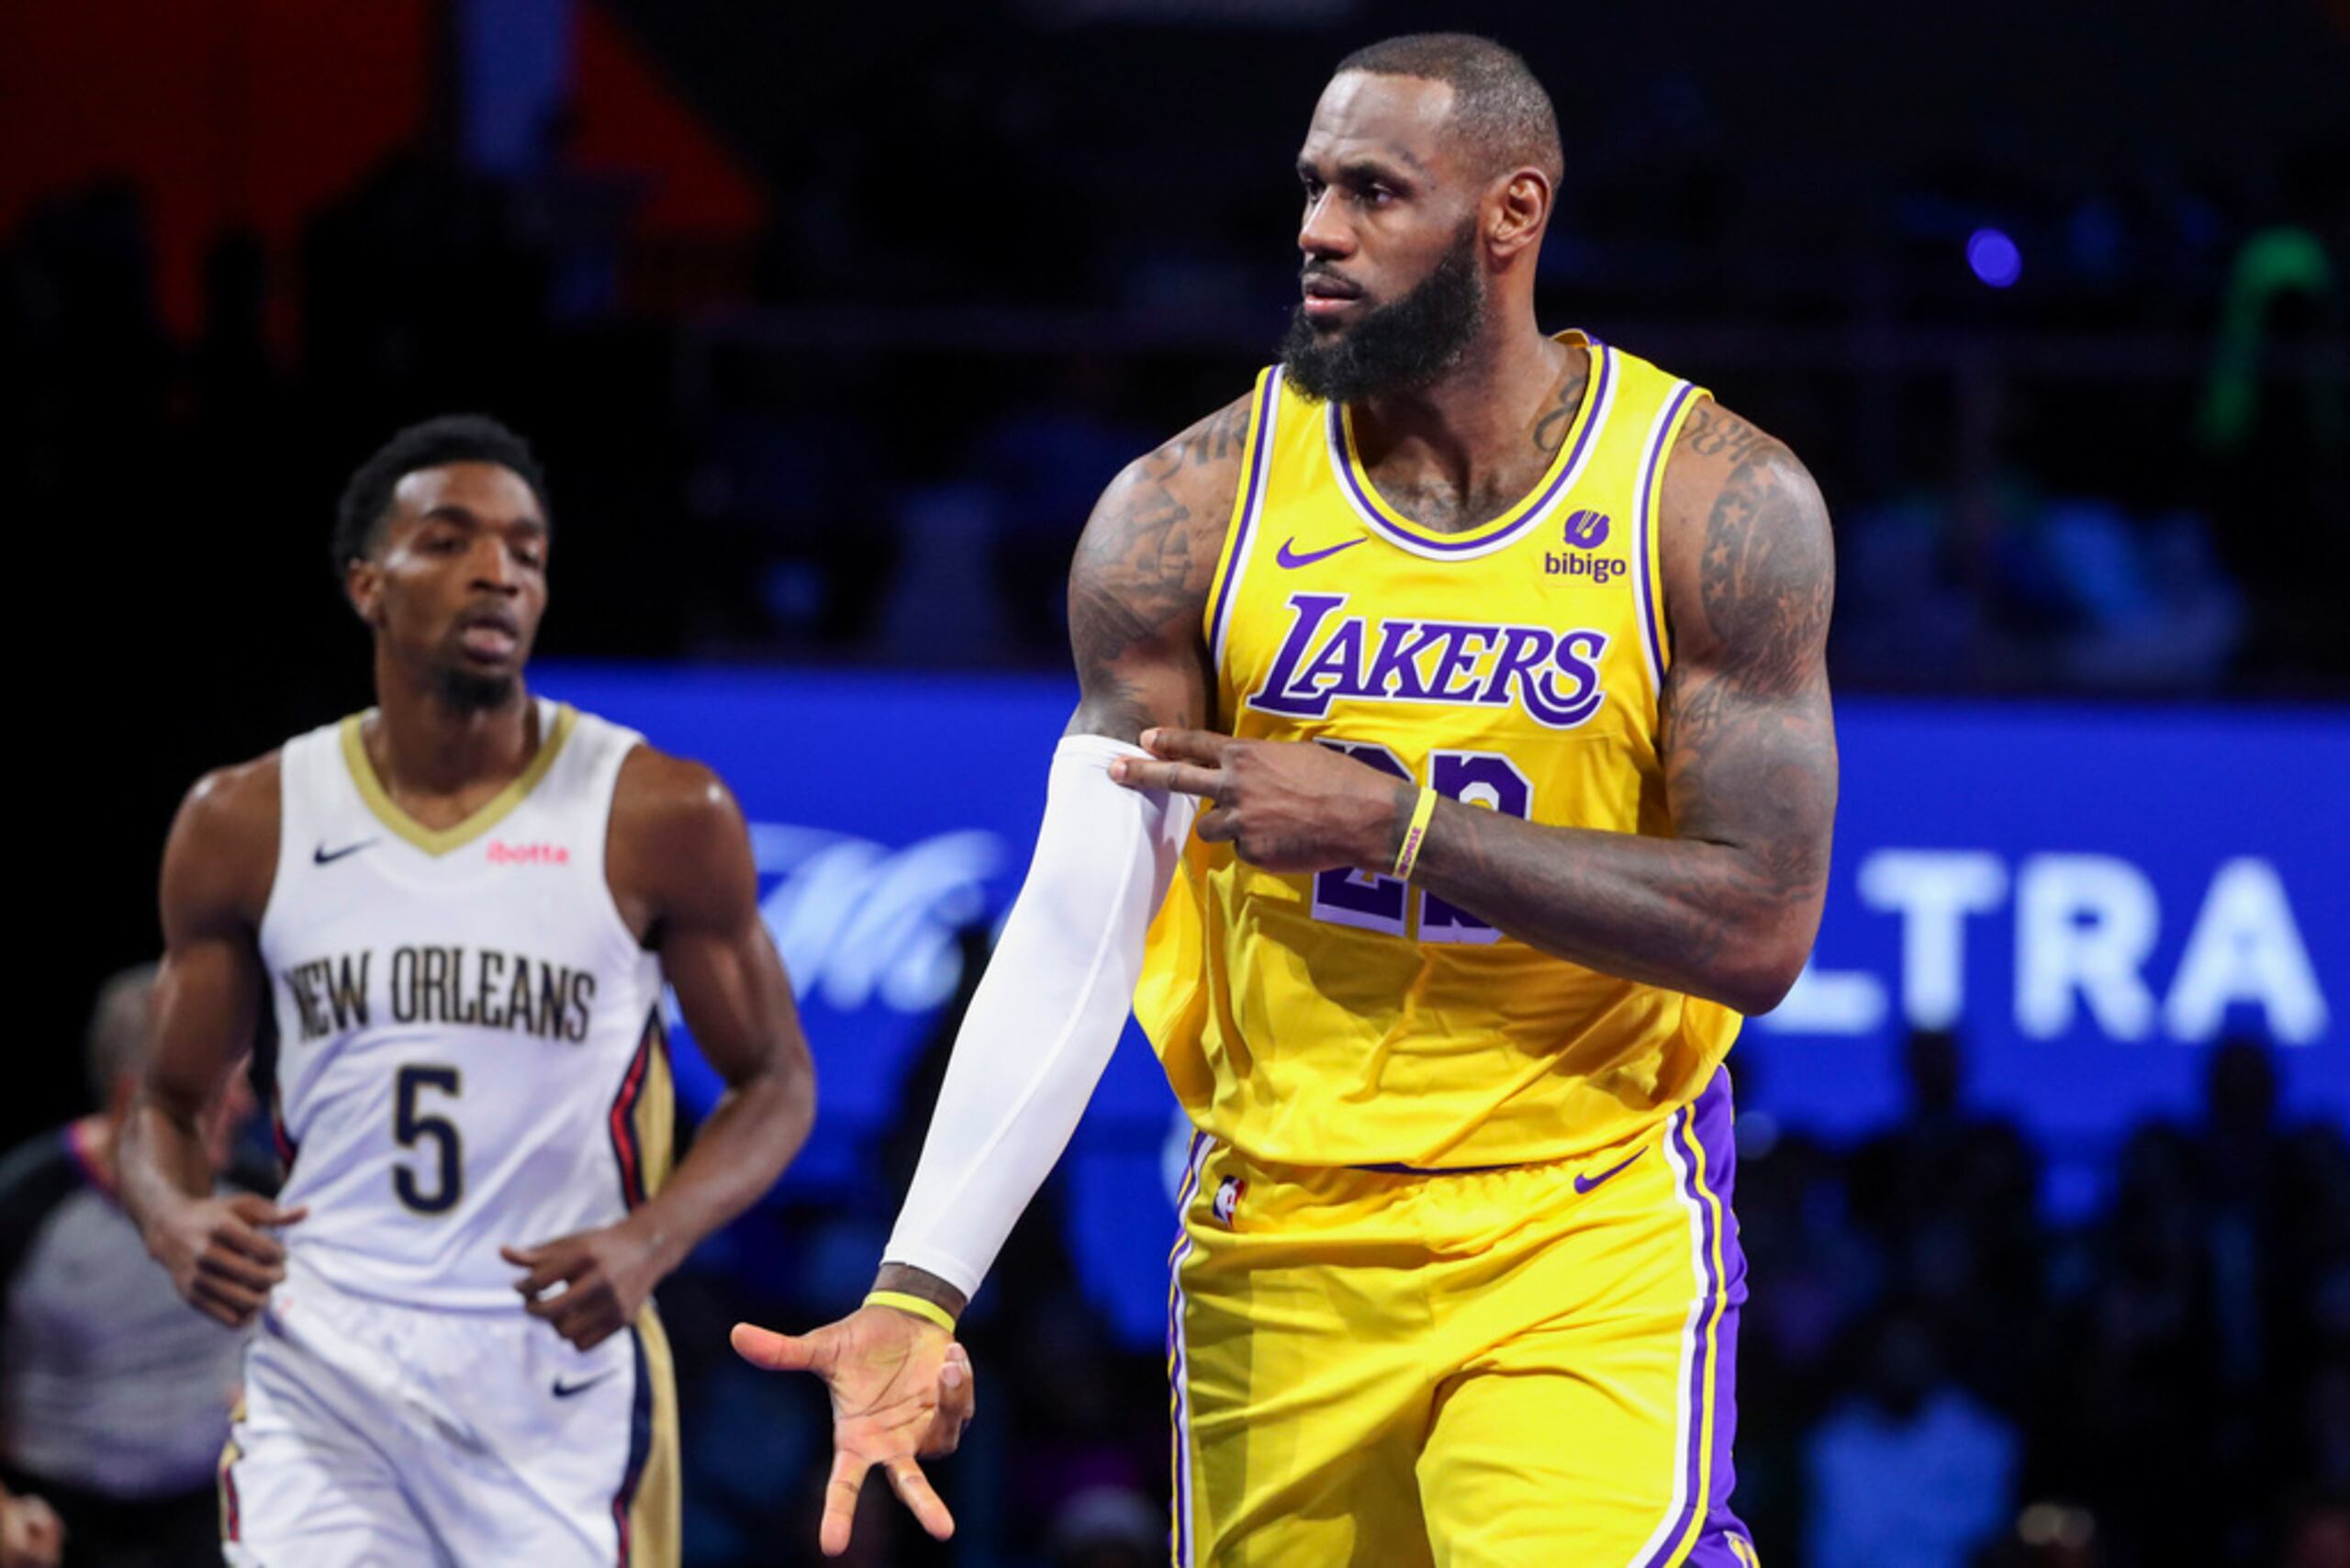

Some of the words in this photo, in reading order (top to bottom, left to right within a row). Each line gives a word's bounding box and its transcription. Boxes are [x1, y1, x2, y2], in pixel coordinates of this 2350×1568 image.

[1545, 552, 1626, 583] bibigo
[1246, 592, 1611, 729] LAKERS
[486, 837, 571, 866] ibotta
[280, 951, 371, 1044] NEW
[391, 946, 598, 1046] ORLEANS
[392, 1061, 464, 1217] 5
